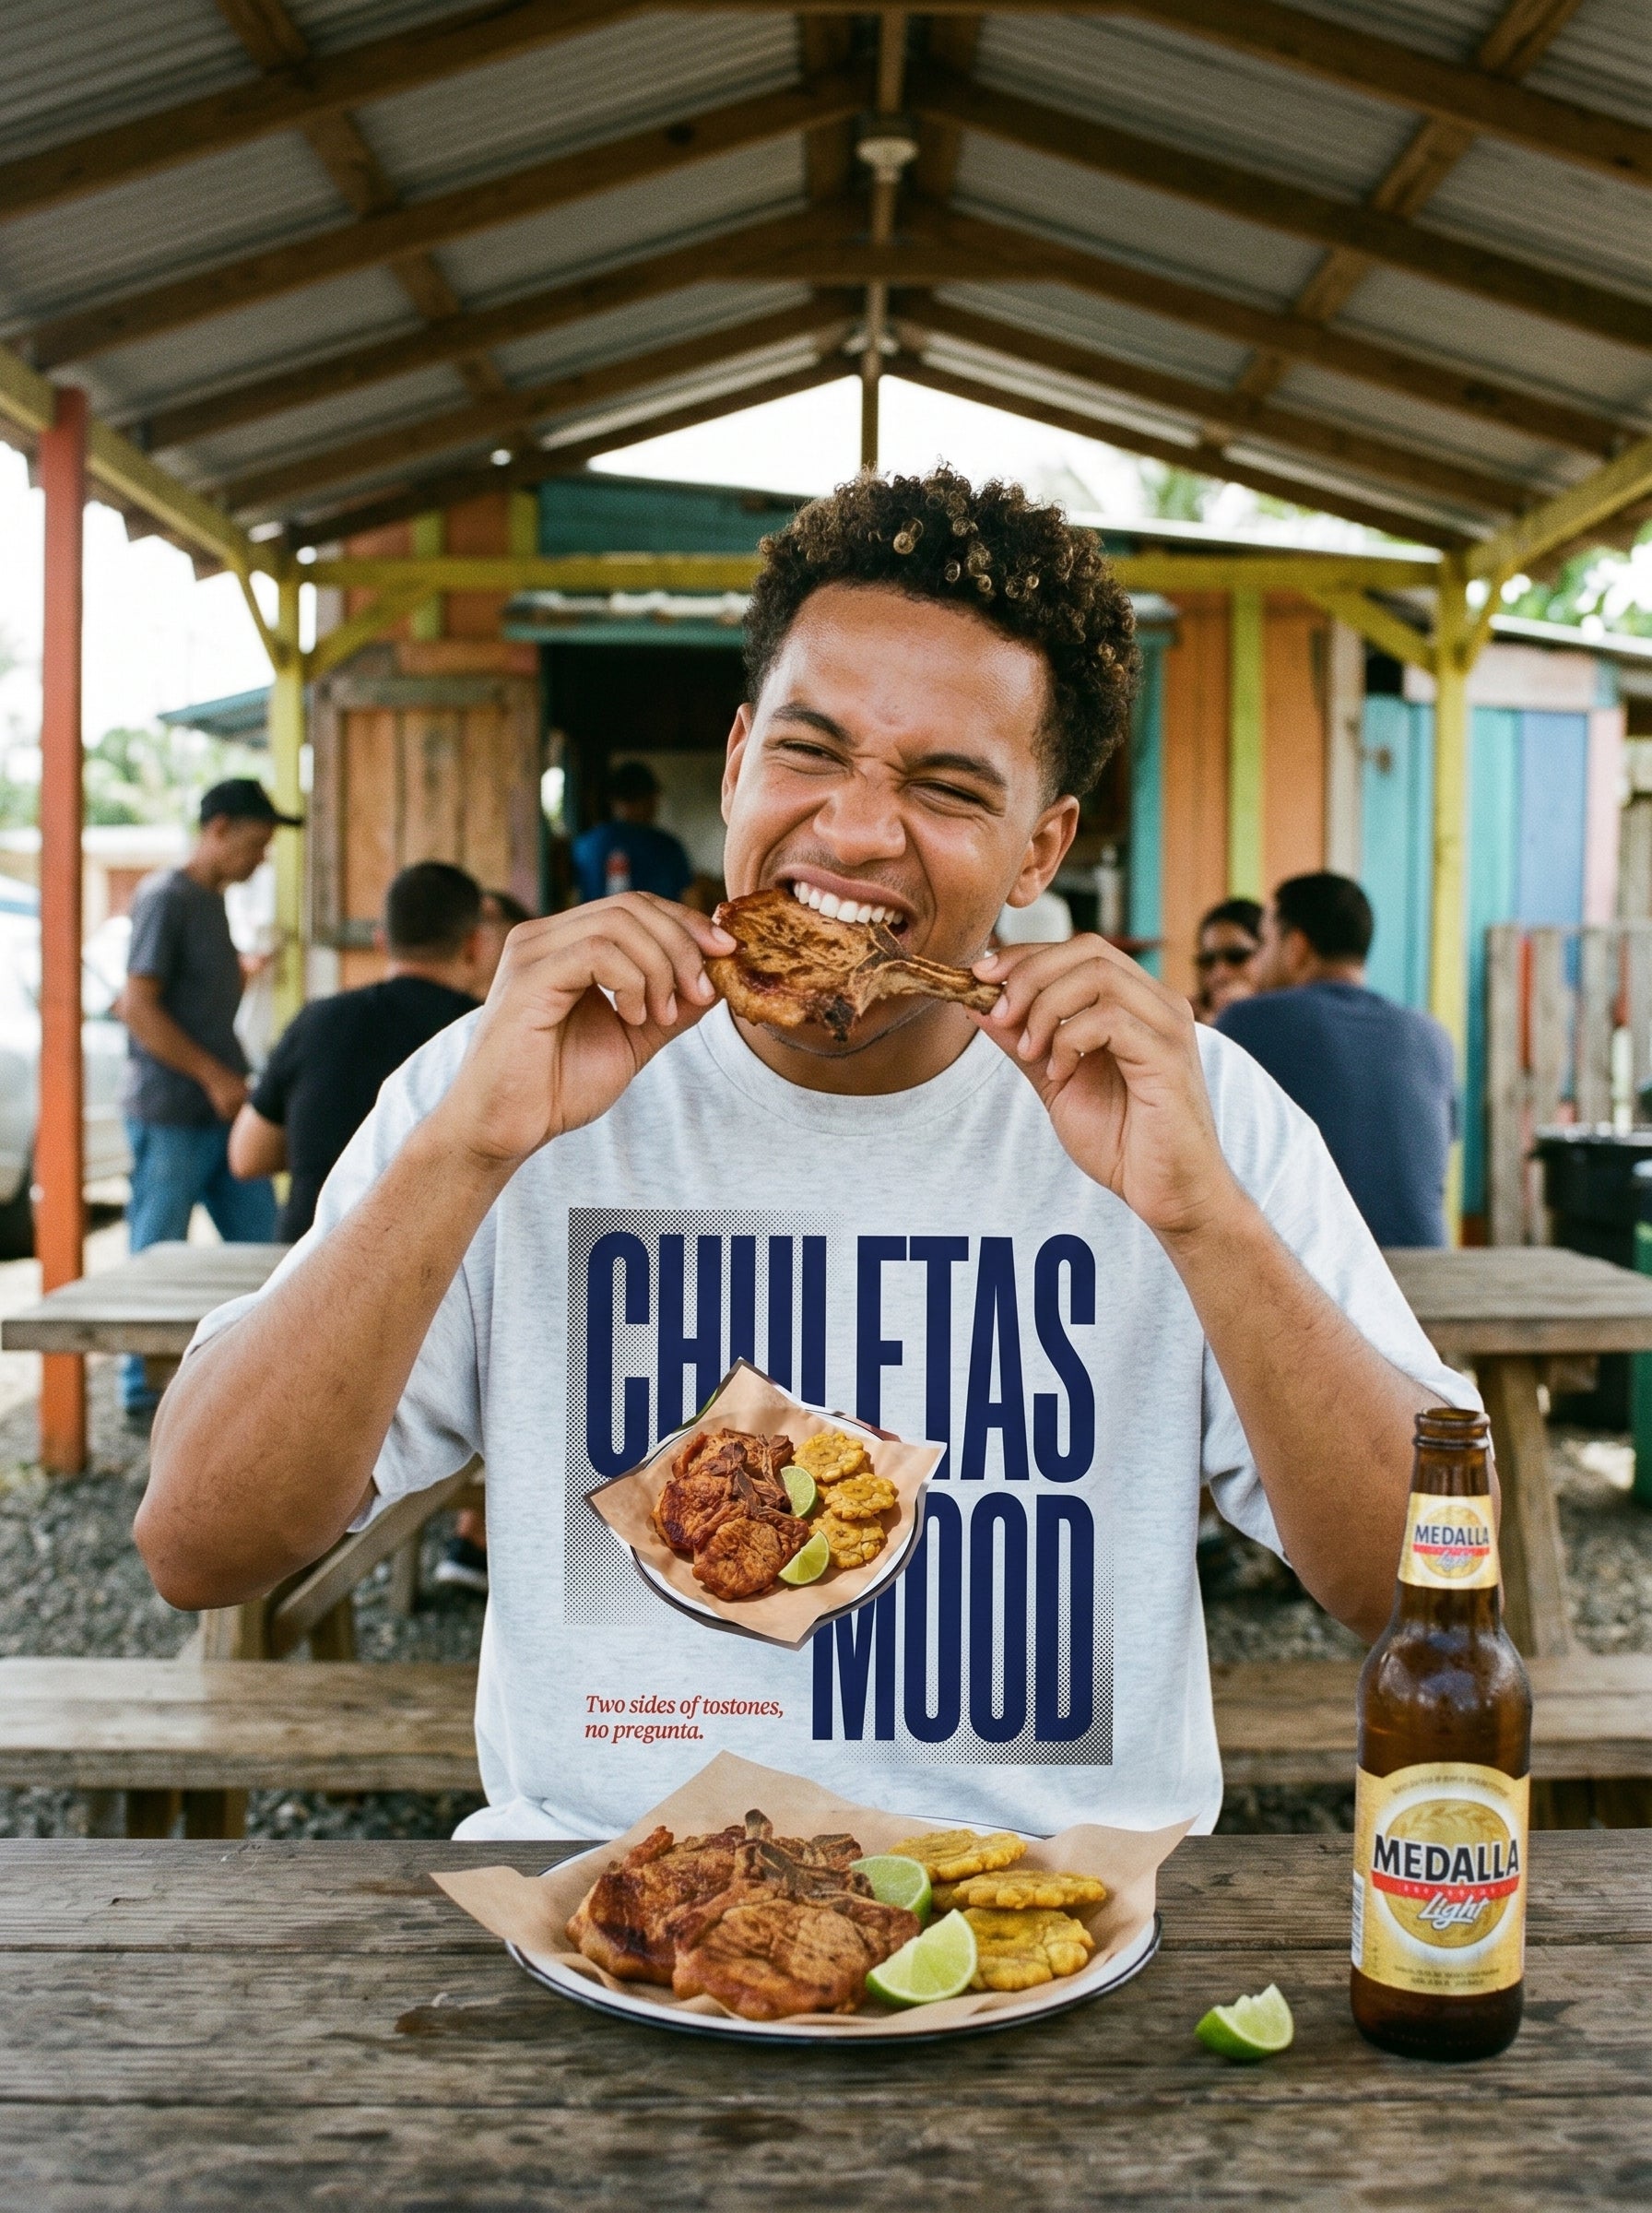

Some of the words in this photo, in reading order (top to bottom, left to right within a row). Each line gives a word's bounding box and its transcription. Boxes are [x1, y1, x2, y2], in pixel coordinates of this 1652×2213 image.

[587, 1231, 1096, 1484] CHULETAS
[1414, 1524, 1489, 1545] MEDALLA
[812, 1491, 1095, 1744] MOOD
[586, 1695, 626, 1713] Two
[629, 1695, 676, 1714] sides
[679, 1695, 702, 1719] of
[702, 1698, 784, 1718] tostones,
[585, 1723, 609, 1739] no
[611, 1723, 704, 1744] pregunta.
[1374, 1833, 1519, 1883] MEDALLA
[1419, 1891, 1490, 1930] Light
